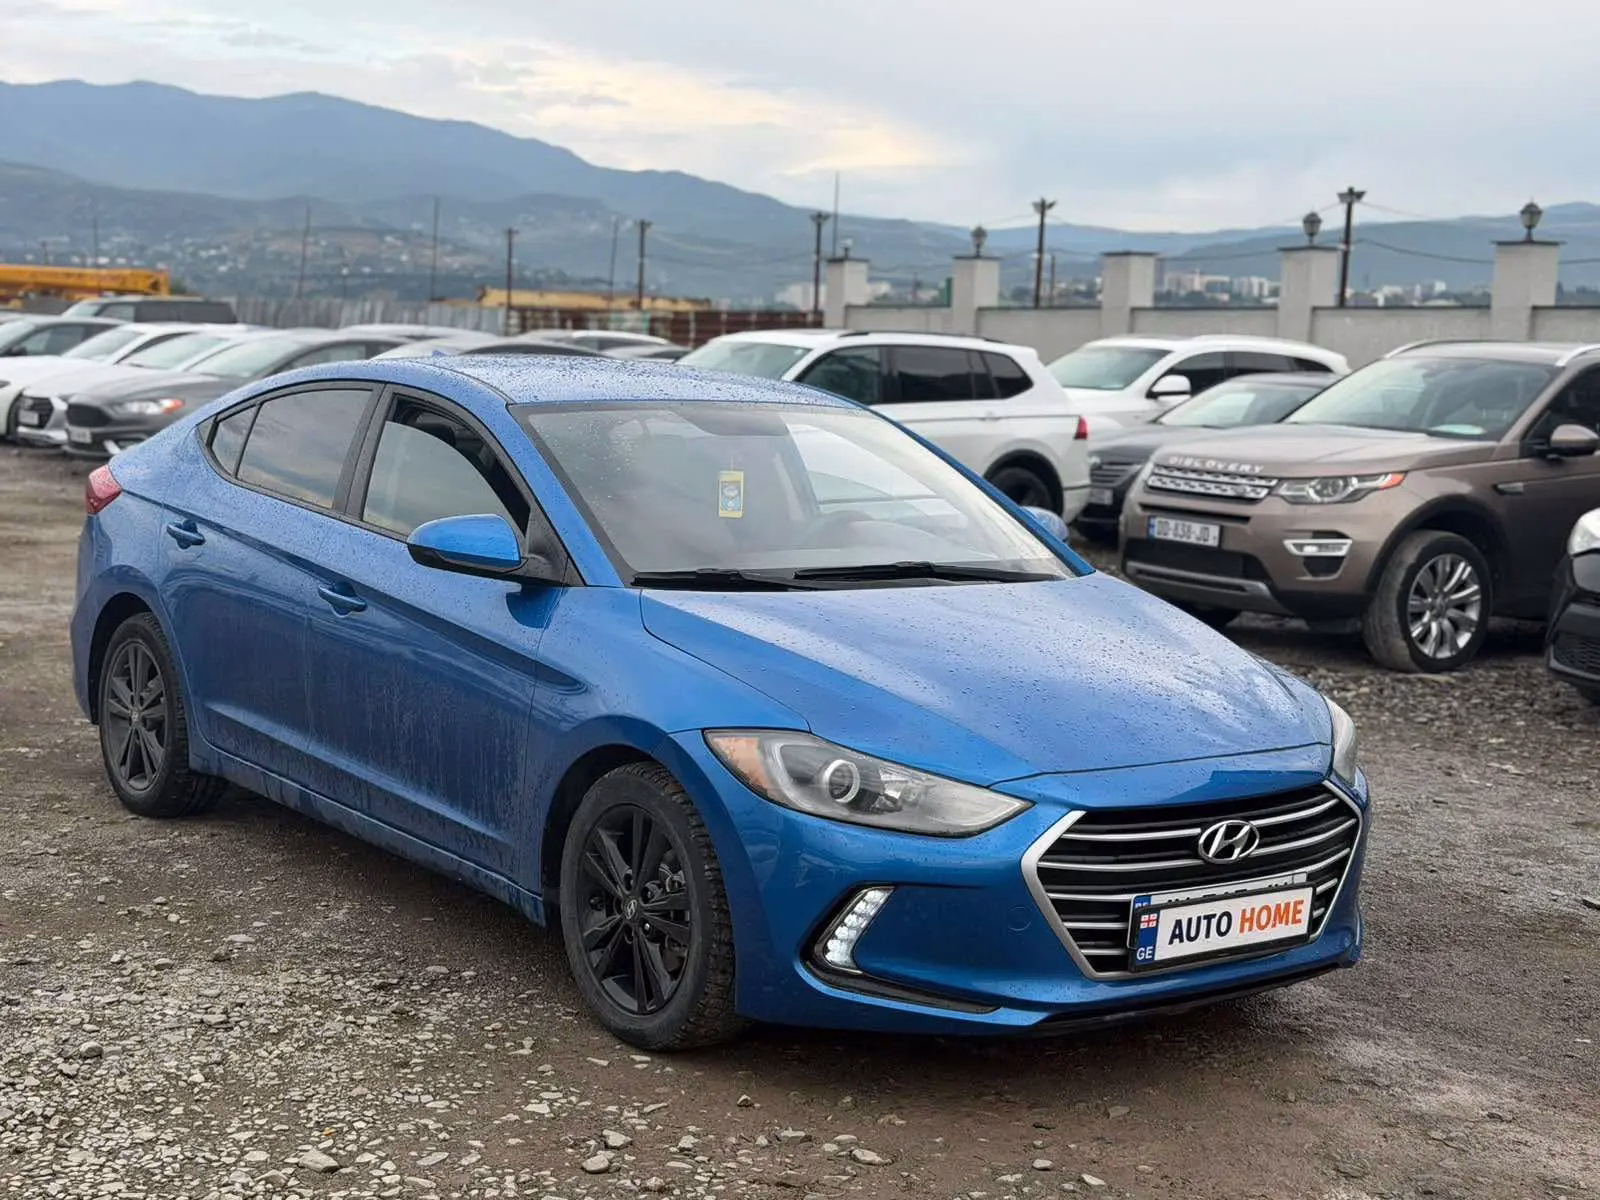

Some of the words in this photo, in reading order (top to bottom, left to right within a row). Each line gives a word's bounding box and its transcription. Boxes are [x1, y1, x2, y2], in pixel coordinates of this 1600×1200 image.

[1169, 456, 1264, 473] DISCOVERY
[1169, 911, 1233, 945] AUTO
[1239, 900, 1304, 934] HOME
[1136, 946, 1153, 960] GE
